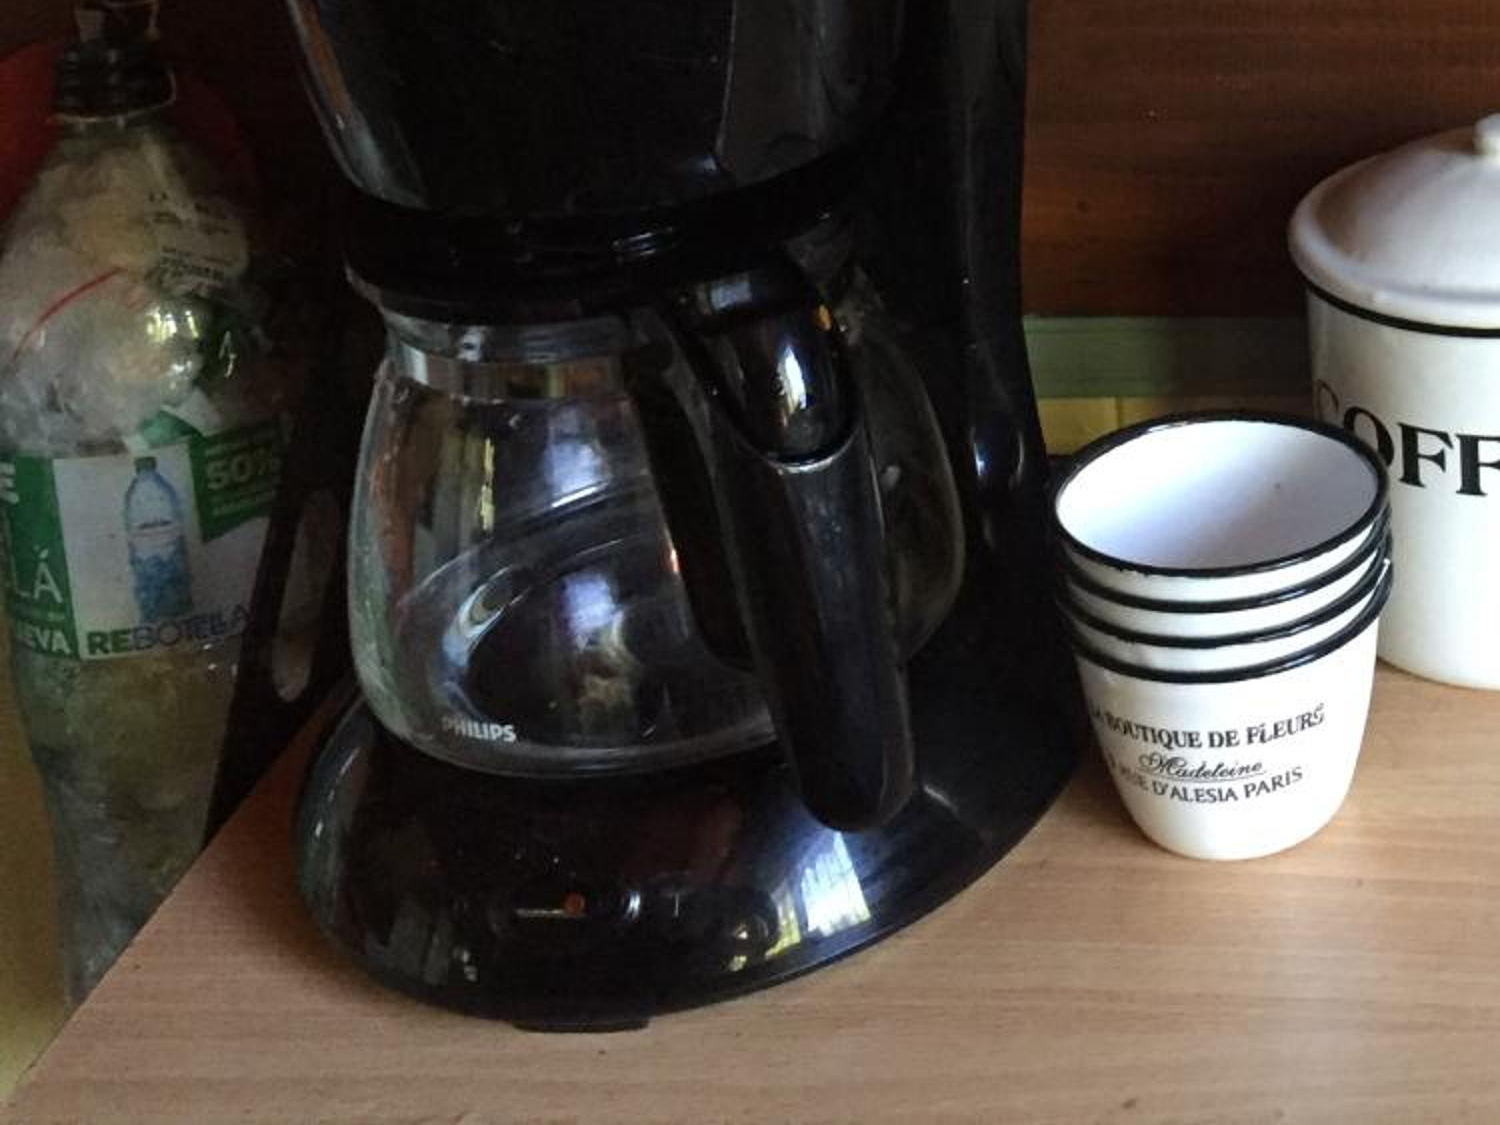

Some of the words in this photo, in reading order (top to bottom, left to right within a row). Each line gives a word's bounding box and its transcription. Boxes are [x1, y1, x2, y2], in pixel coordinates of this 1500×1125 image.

[441, 715, 517, 743] PHILIPS
[1104, 711, 1202, 751] BOUTIQUE
[1208, 730, 1240, 749] DE
[1138, 751, 1265, 778] Madeleine
[1243, 765, 1304, 799] PARIS
